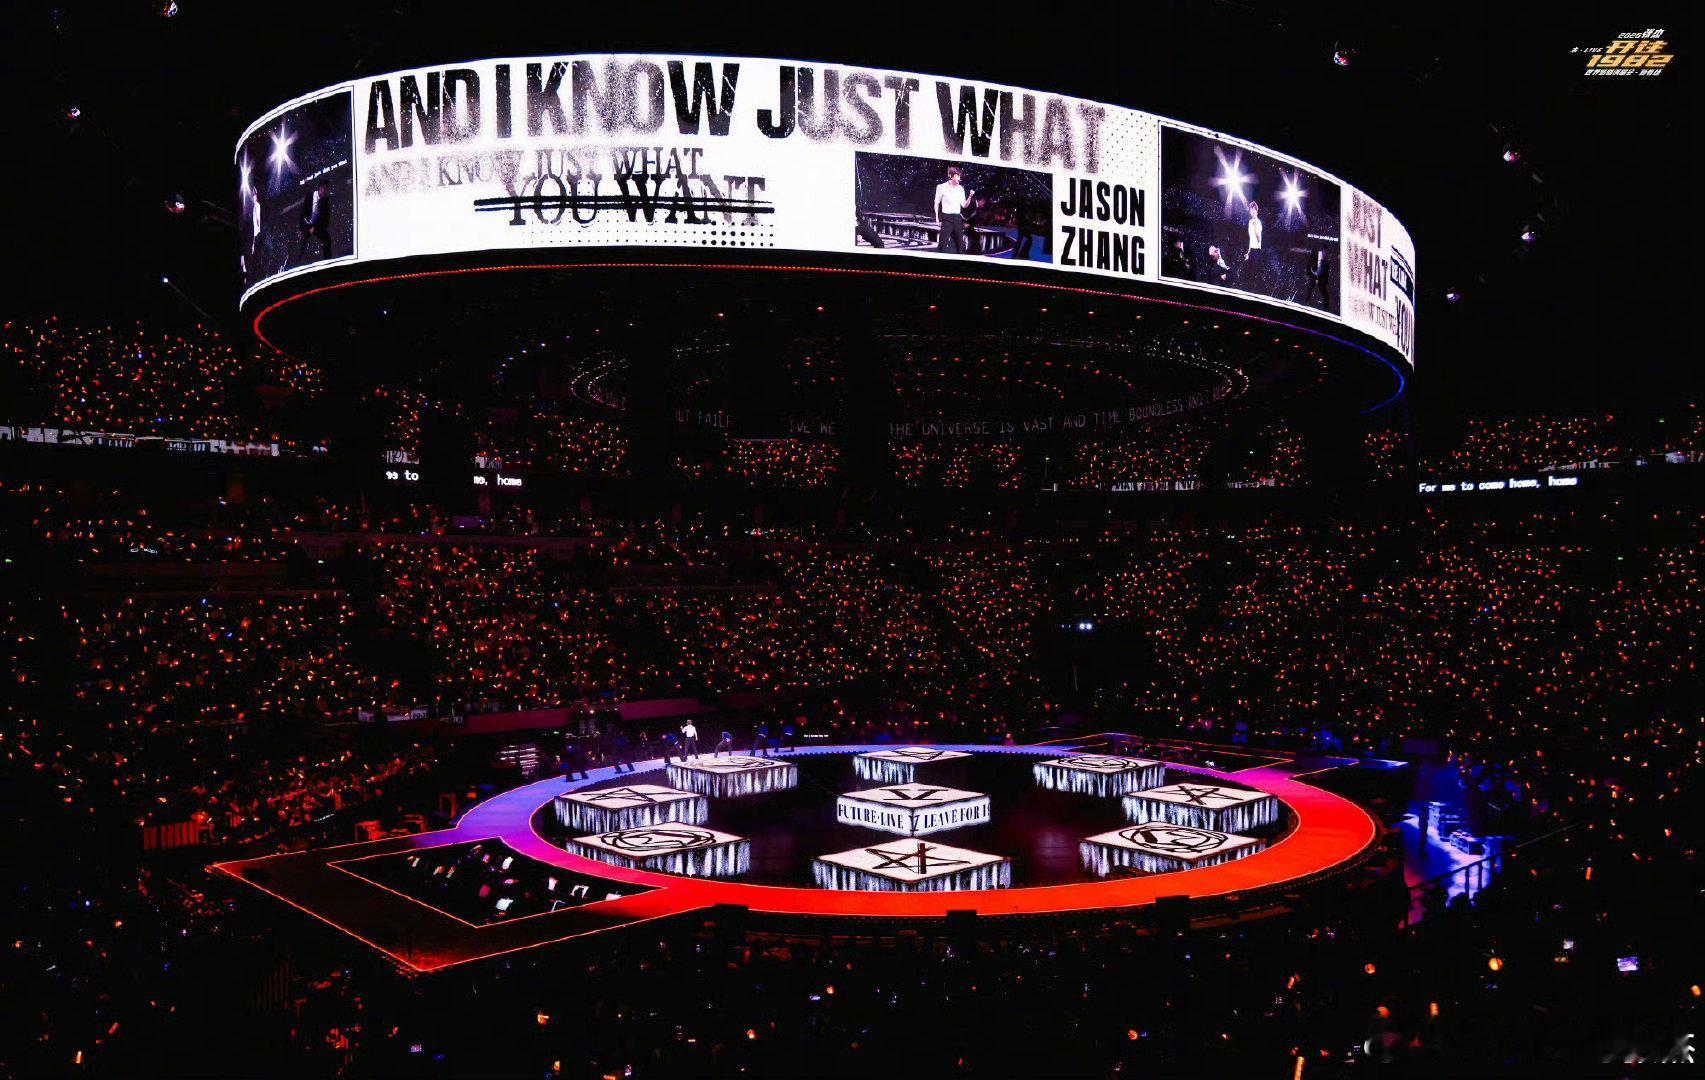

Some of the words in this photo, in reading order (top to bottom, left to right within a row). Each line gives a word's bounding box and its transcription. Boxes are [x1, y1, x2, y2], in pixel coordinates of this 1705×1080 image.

[364, 69, 480, 154] AND
[496, 63, 512, 138] I
[527, 61, 740, 139] KNOW
[757, 65, 919, 149] JUST
[935, 81, 1105, 174] WHAT
[611, 146, 703, 180] WHAT
[501, 173, 602, 226] YOU
[613, 173, 766, 226] WANT
[1060, 177, 1146, 227] JASON
[1347, 190, 1382, 248] JUST
[1060, 225, 1146, 276] ZHANG
[1347, 238, 1388, 301] WHAT
[888, 422, 913, 436] THE
[922, 421, 991, 436] UNIVERSE
[1023, 416, 1054, 432] VAST
[1063, 414, 1087, 428] AND
[1094, 410, 1122, 425] TIME
[1129, 398, 1184, 422] BOUNDLESS
[404, 470, 419, 481] to
[497, 474, 522, 486] home
[1419, 483, 1437, 493] For
[1442, 484, 1456, 492] me
[1461, 481, 1474, 491] to
[1479, 481, 1505, 490] come
[1509, 477, 1541, 489] home,
[1548, 475, 1577, 487] home
[924, 809, 958, 829] LEAVE
[960, 804, 980, 819] FOR
